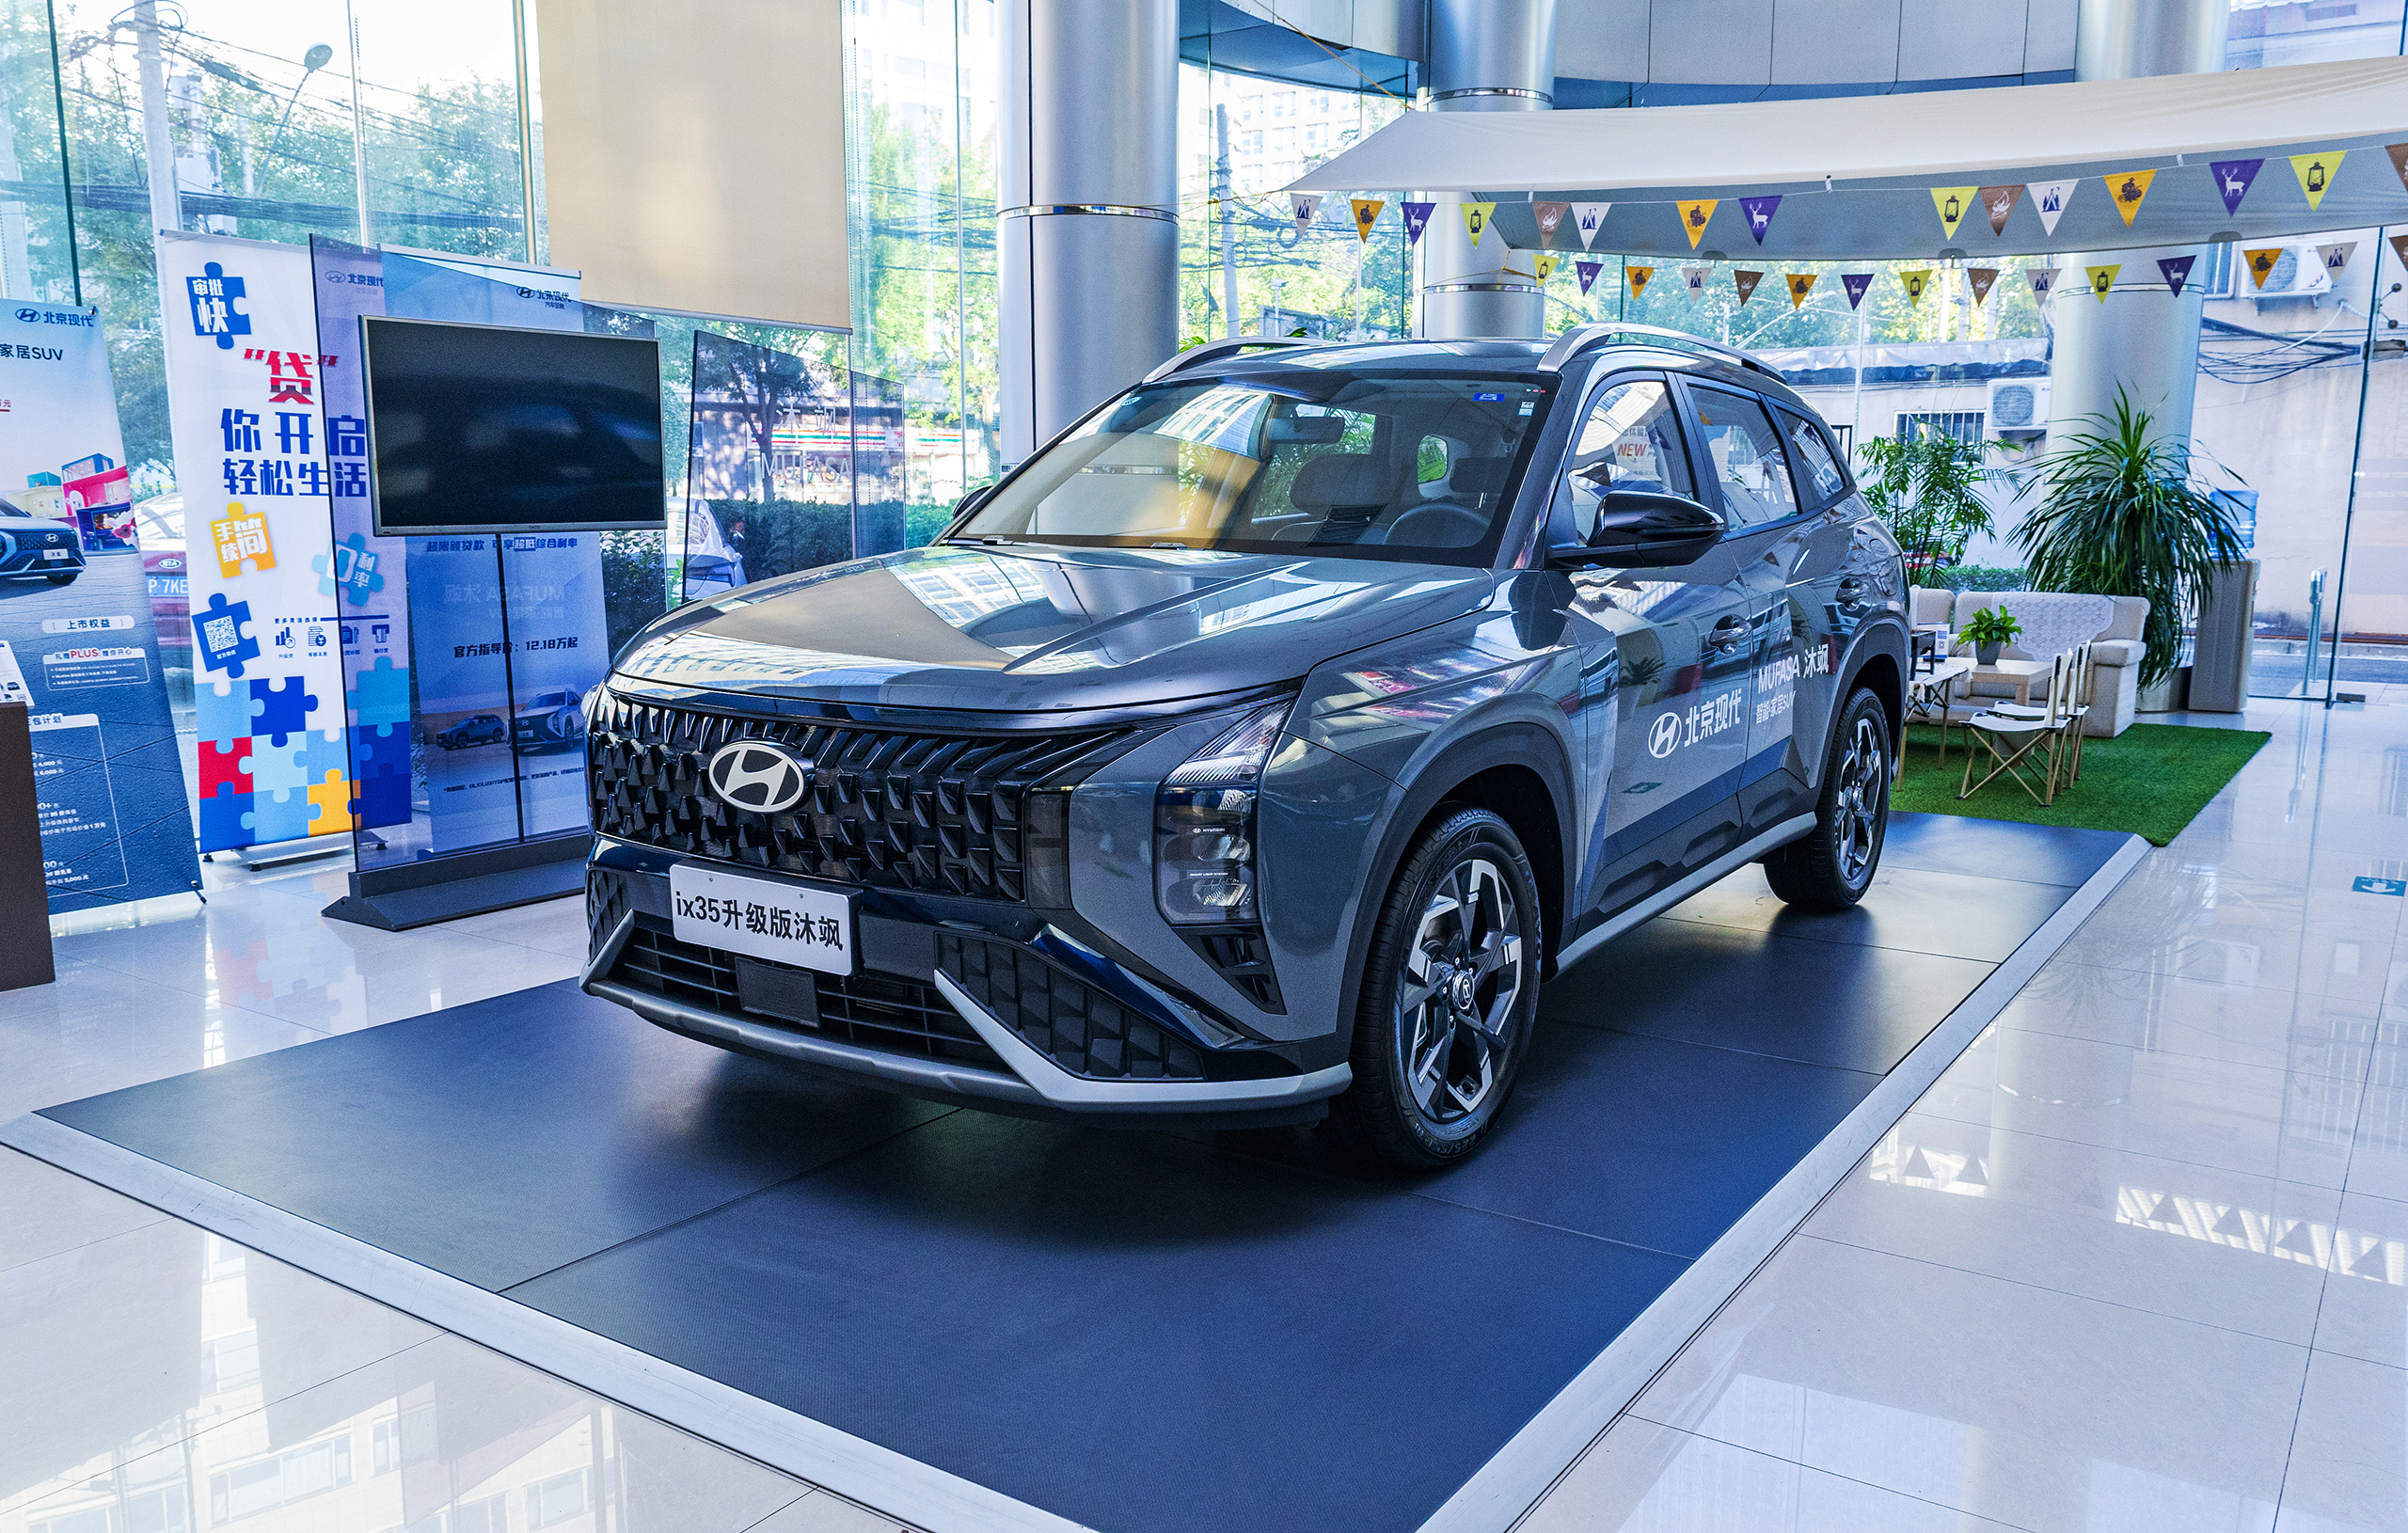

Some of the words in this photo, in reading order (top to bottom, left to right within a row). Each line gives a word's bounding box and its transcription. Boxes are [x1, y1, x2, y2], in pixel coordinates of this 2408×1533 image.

[192, 278, 225, 297] 审批
[43, 311, 94, 327] 北京现代
[197, 297, 230, 334] 快
[0, 343, 64, 361] 家居SUV
[220, 408, 366, 457] 你开启
[1617, 443, 1647, 457] NEW
[222, 458, 368, 498] 轻松生活
[760, 451, 854, 483] MUFASA
[233, 517, 268, 559] 简
[353, 551, 376, 588] 利率
[67, 618, 111, 630] 上市权益
[1758, 654, 1800, 694] MUFASA
[1802, 643, 1830, 679] 沐飒
[1684, 687, 1742, 748] 北京现代
[675, 891, 844, 952] ix35升级版沐飒
